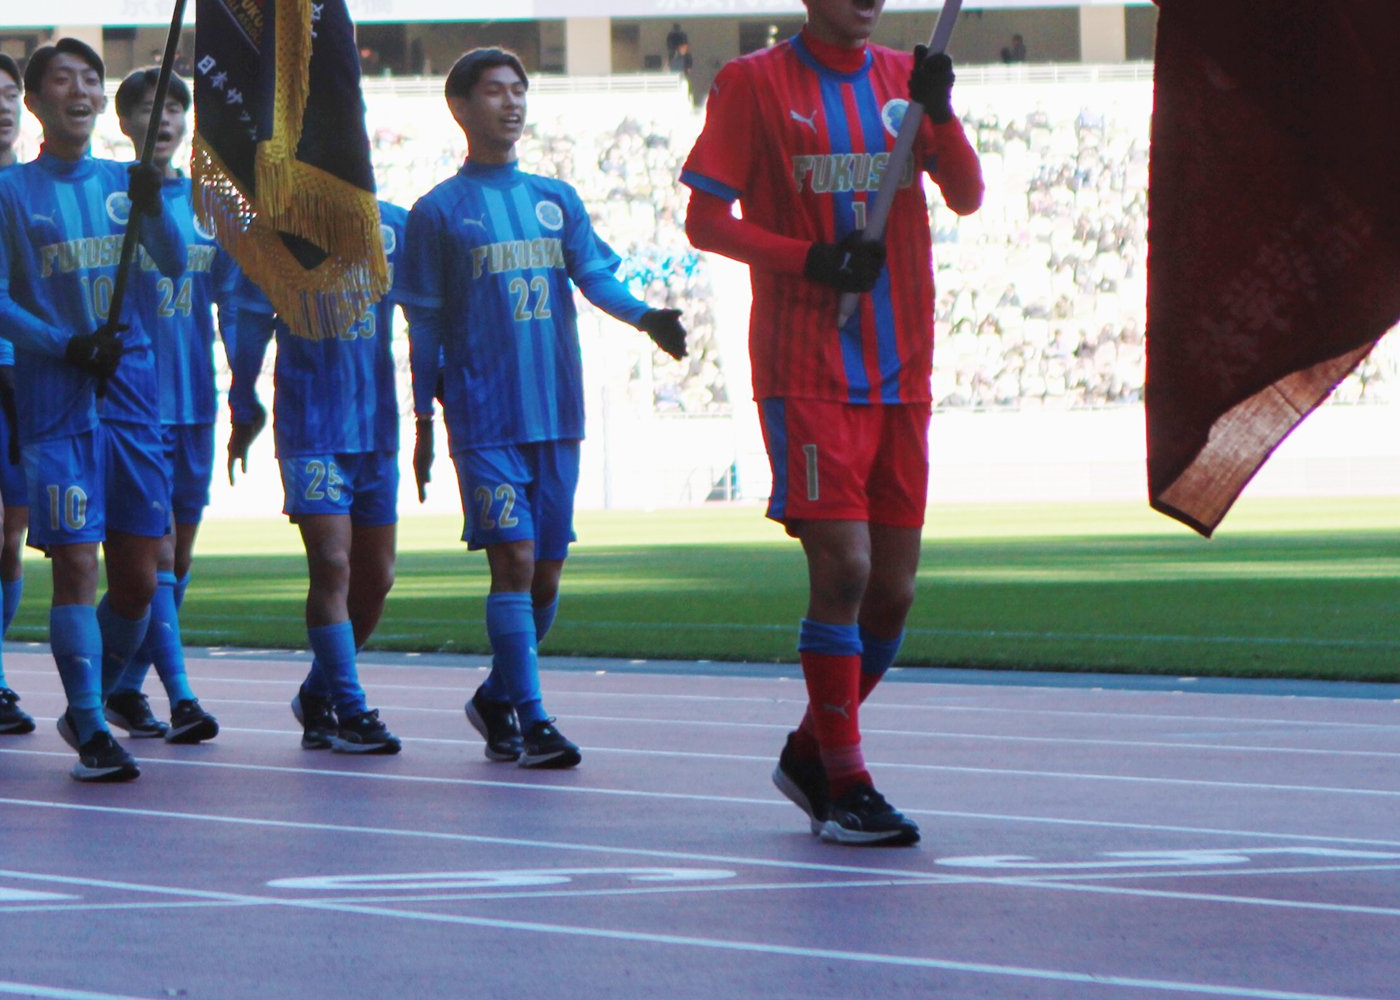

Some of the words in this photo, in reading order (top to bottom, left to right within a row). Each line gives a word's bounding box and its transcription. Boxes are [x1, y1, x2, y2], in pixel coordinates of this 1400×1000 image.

[790, 152, 914, 193] FUKUSO
[851, 202, 866, 235] 1
[80, 275, 114, 320] 10
[156, 277, 192, 317] 24
[508, 276, 552, 321] 22
[305, 459, 344, 501] 25
[802, 443, 820, 501] 1
[45, 472, 87, 531] 10
[474, 482, 519, 530] 22
